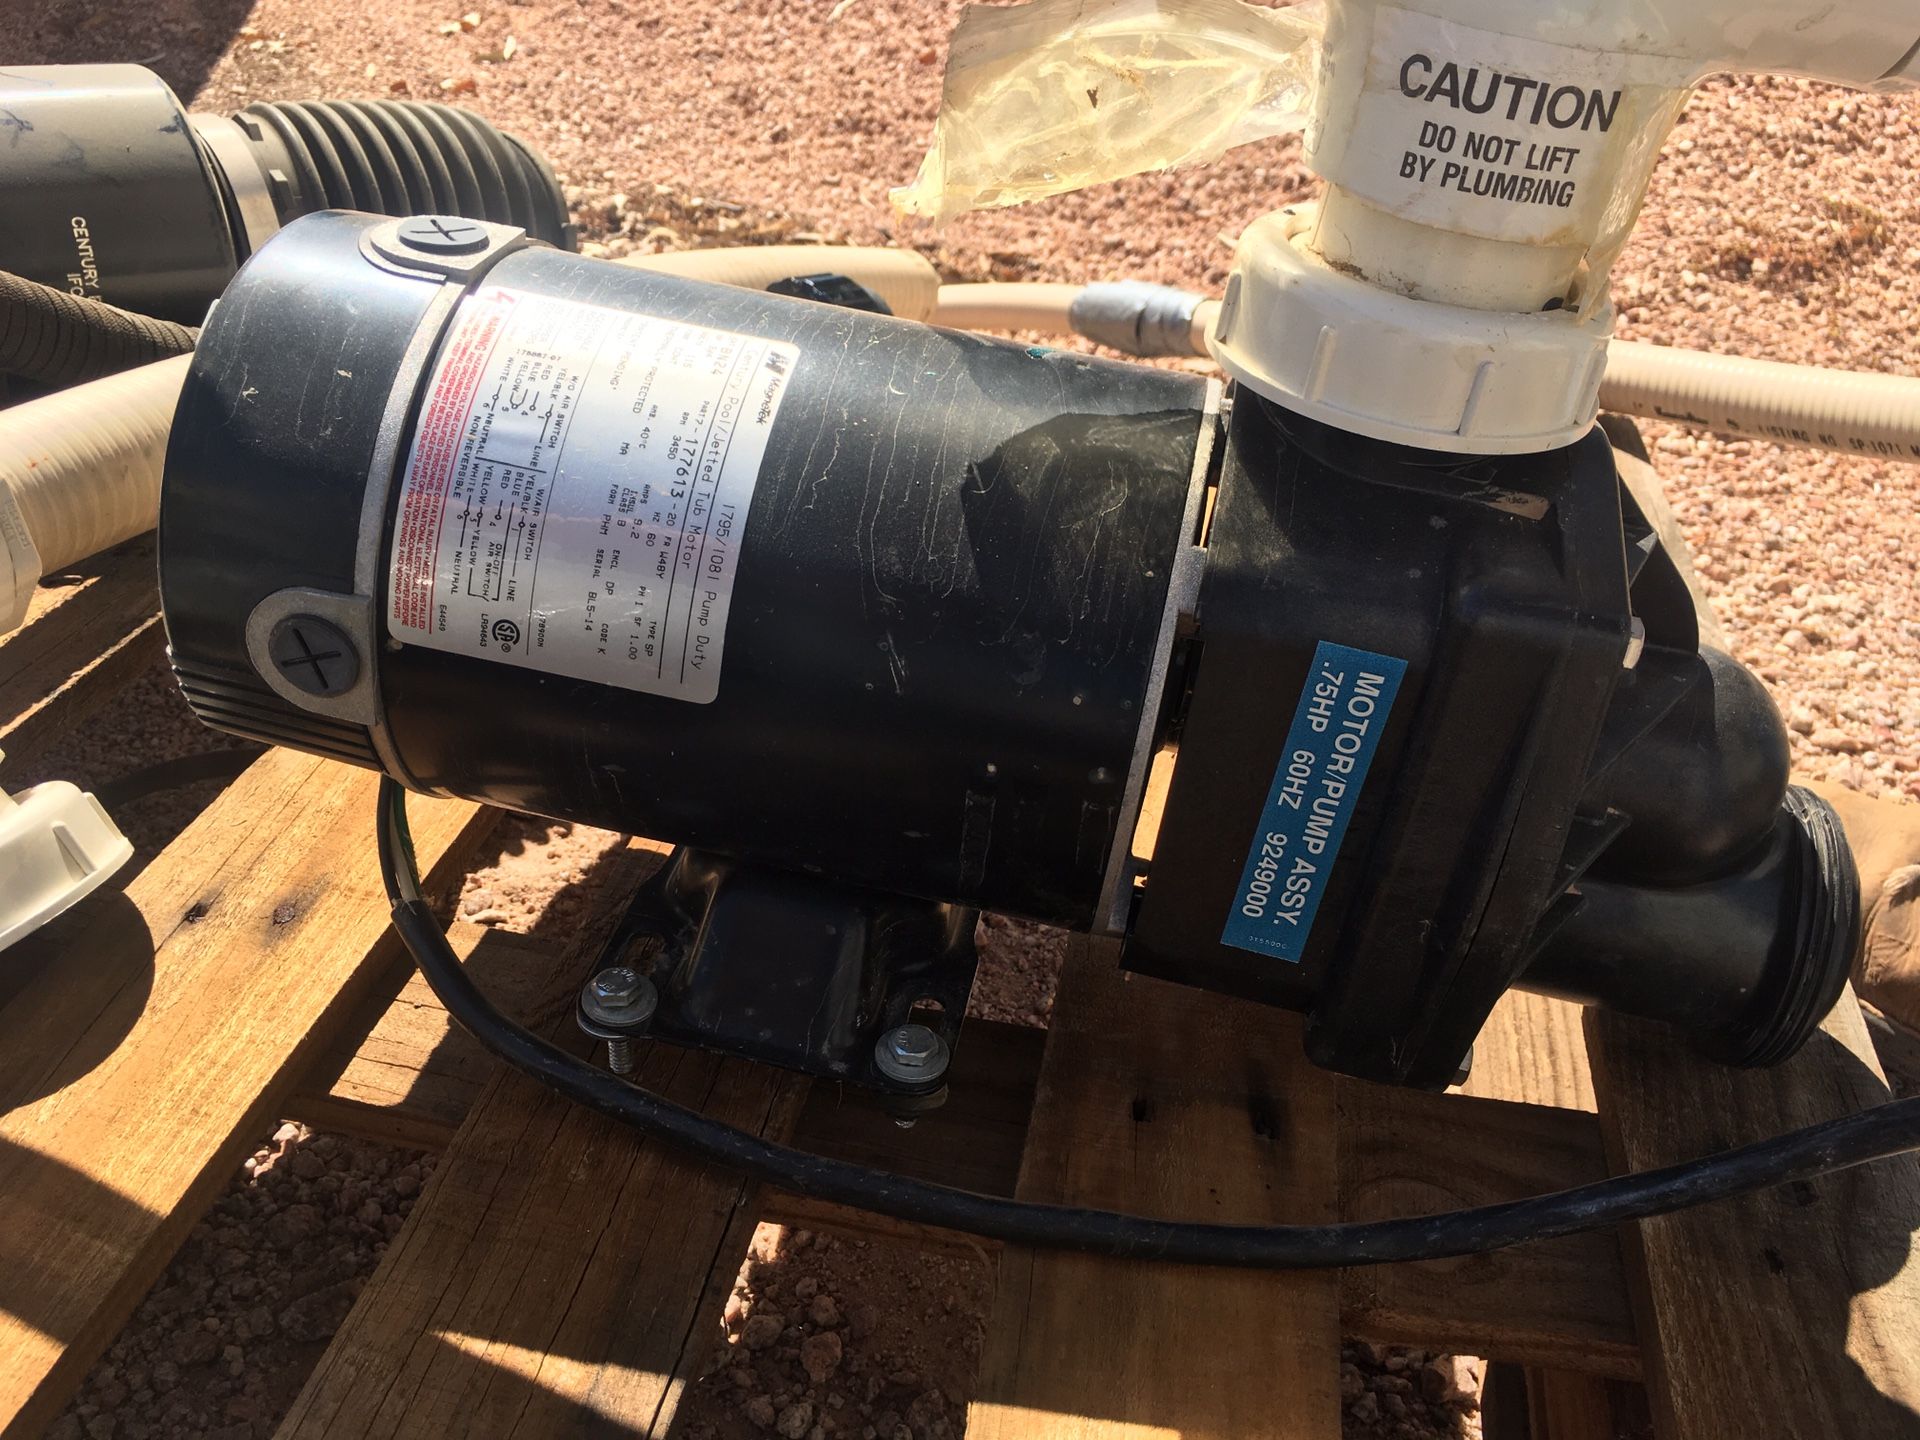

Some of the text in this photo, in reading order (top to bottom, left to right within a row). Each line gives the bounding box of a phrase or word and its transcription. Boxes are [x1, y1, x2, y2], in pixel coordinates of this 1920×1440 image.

[1400, 53, 1621, 132] CAUTION
[1418, 120, 1580, 174] DO NOT LIFT
[1400, 151, 1575, 208] BY PLUMBING
[71, 216, 100, 288] CENTURY
[499, 356, 514, 381] WHITE
[510, 359, 530, 392] YELLOW
[527, 361, 542, 382] BLUE
[539, 363, 553, 380] RED
[549, 367, 568, 400] YEL/BLK
[632, 366, 657, 414] PROTECTED
[547, 374, 579, 448] W/O AIR SWITCH
[755, 376, 781, 426] MagneTek
[468, 415, 481, 436] NON
[679, 411, 689, 425] RPM
[475, 412, 494, 455] NEUTRAL
[666, 433, 682, 460] 3450
[700, 396, 739, 483] Pool/Jetted
[529, 445, 542, 467] LINE
[618, 441, 629, 455] MA
[465, 462, 480, 493] WHITE
[476, 464, 494, 504] YELLOW
[499, 469, 511, 489] RED
[511, 471, 524, 496] BLUE
[519, 473, 536, 513] YEL/BLK
[606, 484, 618, 504] FORM
[617, 487, 630, 512] CLASS
[639, 483, 650, 504] AMPS
[692, 490, 710, 517] Tub
[523, 488, 544, 560] W/AIR SWITCH
[599, 514, 611, 535] PHM
[629, 518, 643, 539] 9.2
[651, 511, 660, 522] HZ
[405, 526, 416, 572] DISCONNECT
[467, 529, 481, 565] YELLOW
[486, 541, 496, 557] AIR
[645, 532, 655, 546] 60
[662, 535, 671, 546] FR
[680, 524, 702, 569] Motor
[449, 550, 463, 595] NEUTRAL
[591, 548, 604, 579] SERIAL
[609, 549, 619, 570] ENCL
[655, 551, 668, 579] W48Y
[506, 579, 516, 601] LINE
[603, 581, 614, 595] DP
[637, 585, 646, 596] PH
[689, 503, 734, 670] 1795/1081 Pump Duty
[418, 592, 426, 629] INSTALLED
[599, 623, 608, 642] CODE
[647, 620, 657, 640] TYPE
[627, 633, 639, 660] 1.00
[643, 643, 653, 657] SP
[1307, 661, 1344, 733] .75HP
[1278, 749, 1315, 810] 60HZ
[1274, 671, 1385, 926] MOTOR/PUMP ASSY.
[1243, 832, 1288, 918] 9249000
